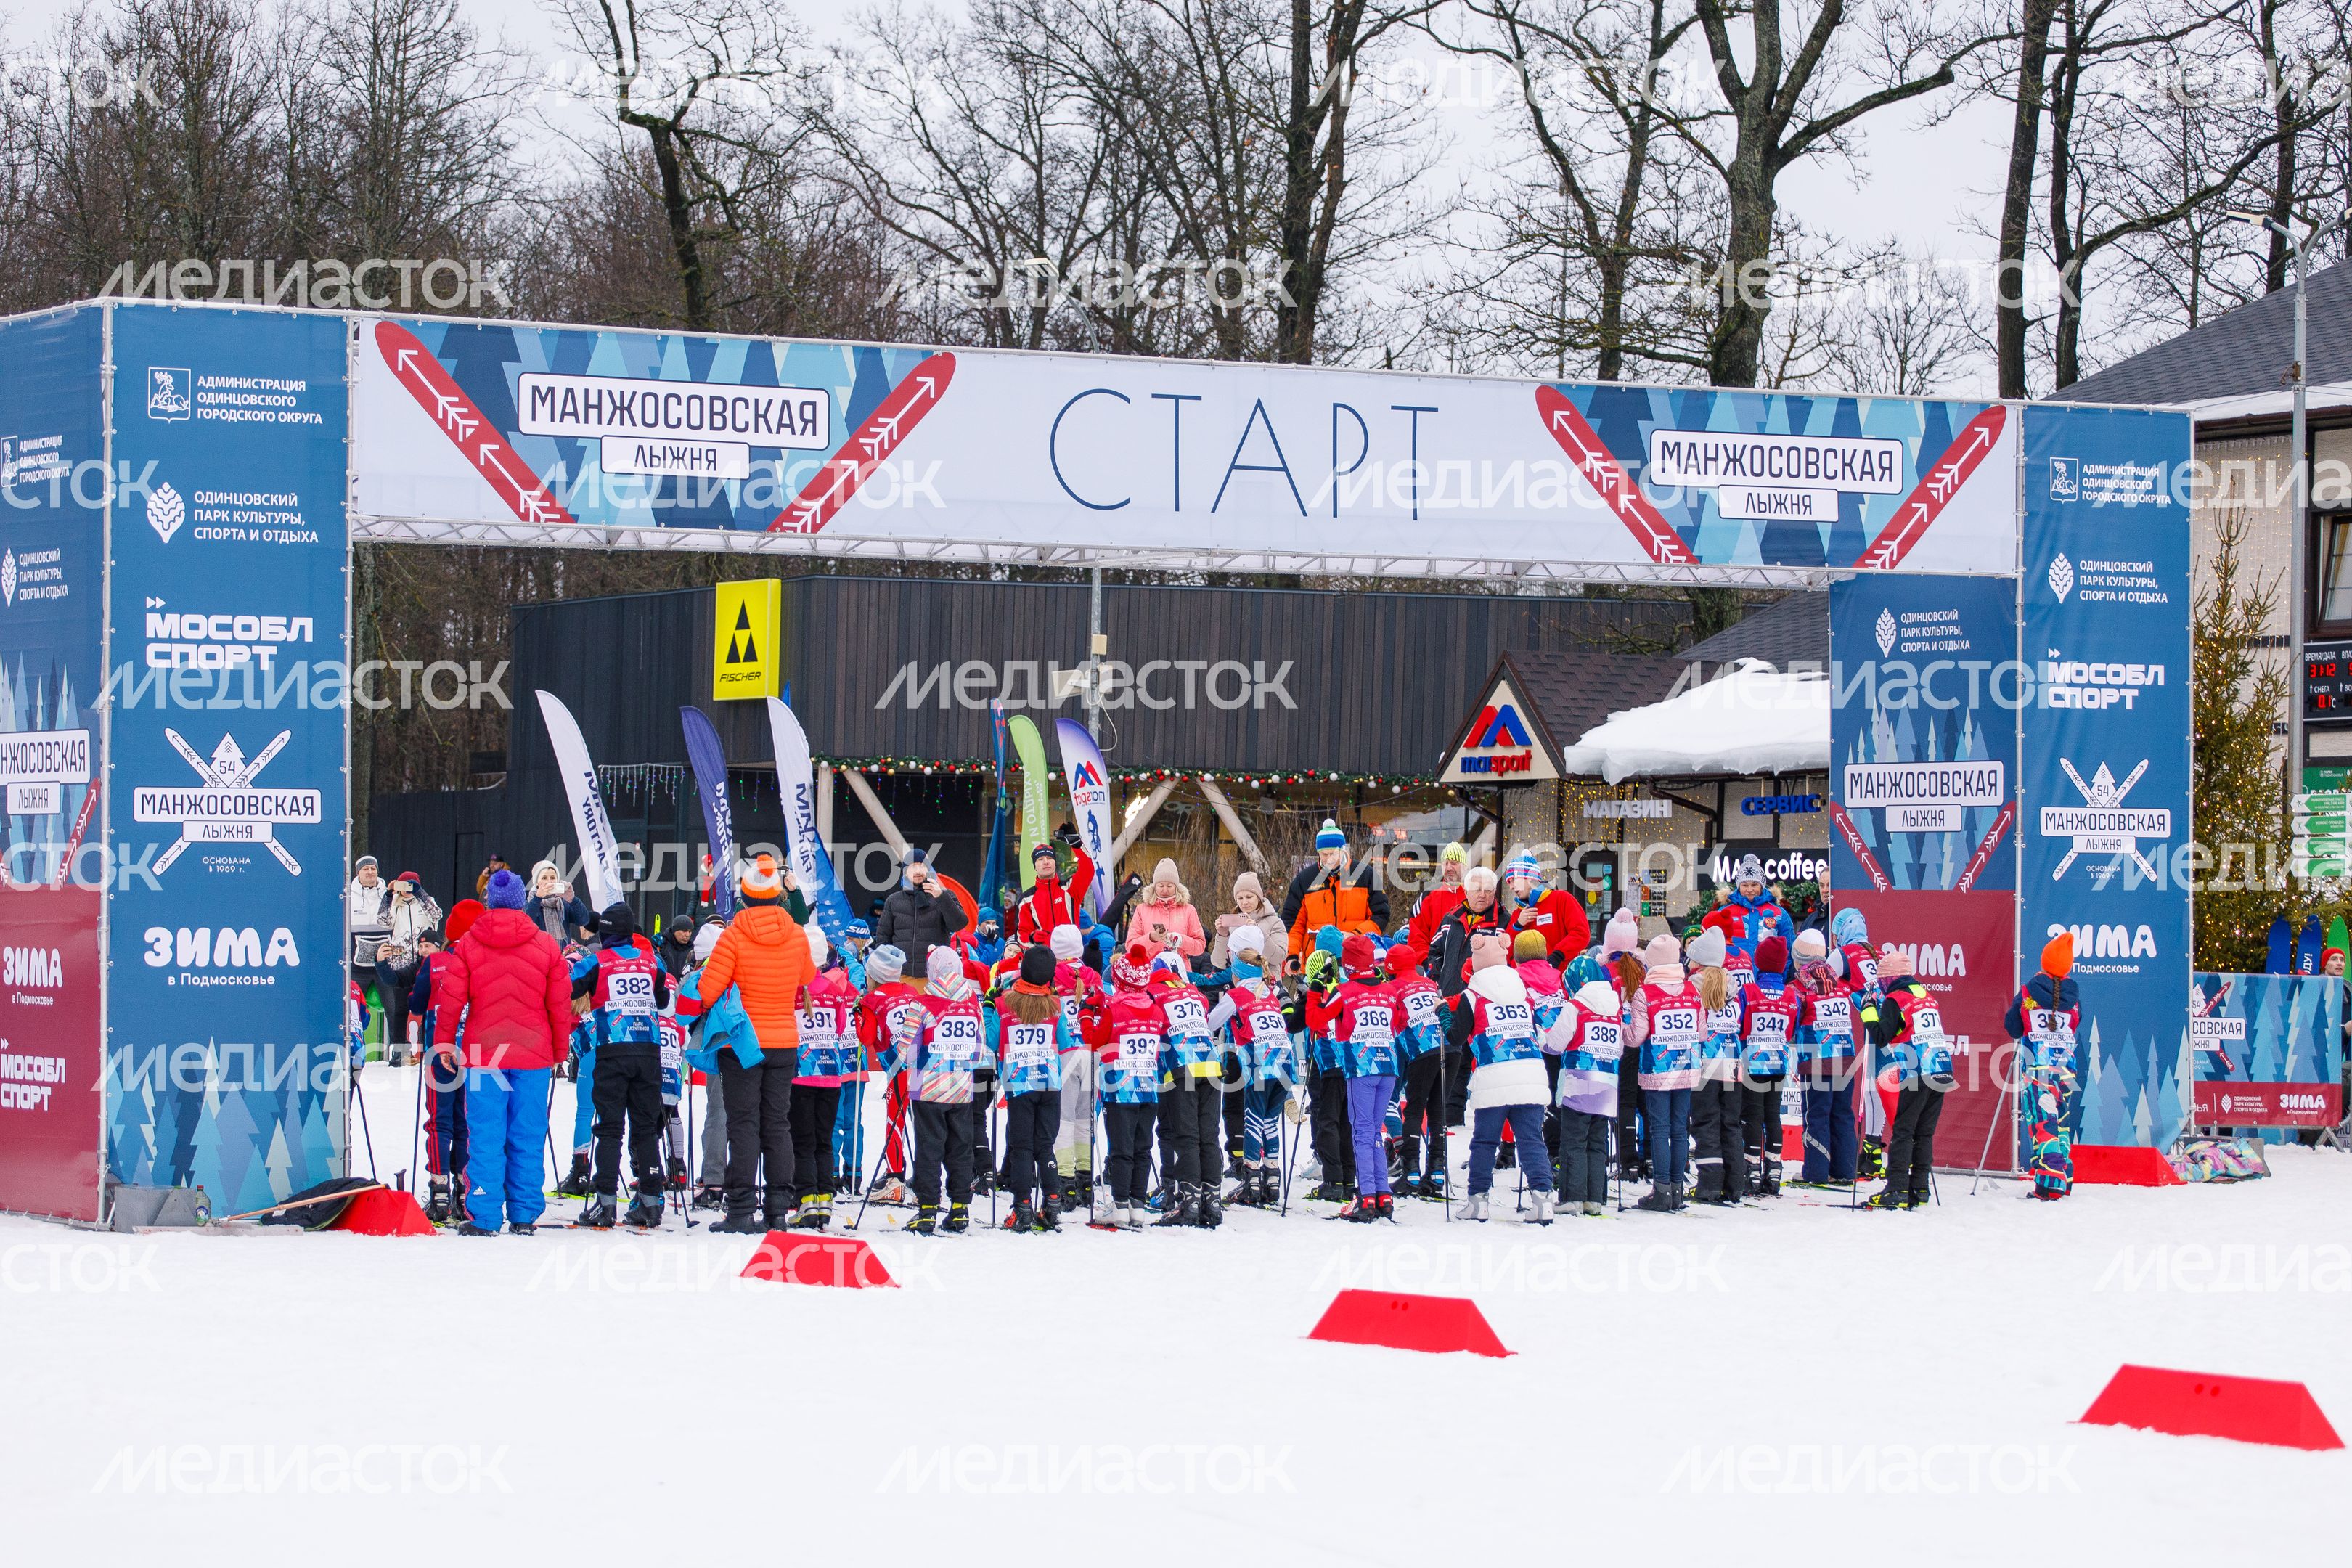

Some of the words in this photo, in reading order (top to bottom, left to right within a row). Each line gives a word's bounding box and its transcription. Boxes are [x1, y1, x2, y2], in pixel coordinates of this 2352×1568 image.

[197, 376, 306, 392] АДМИНИСТРАЦИЯ
[197, 392, 296, 407] ОДИНЦОВСКОГО
[197, 408, 276, 422] ГОРОДСКОГО
[278, 411, 323, 425] ОКРУГА
[531, 385, 818, 436] МАНЖОСОВСКАЯ
[20, 436, 63, 452] АДМИНИСТРАЦИЯ
[20, 452, 59, 468] ОДИНЦОВСКОГО
[634, 444, 717, 472] ЛЫЖНЯ
[1050, 388, 1439, 521] СТАРТ
[1661, 441, 1893, 483] МАНЖОСОВСКАЯ
[20, 468, 51, 483] ГОРОДСКОГО
[51, 467, 70, 479] ОКРУГА
[2083, 465, 2160, 478] АДМИНИСТРАЦИЯ
[2083, 478, 2152, 491] ОДИНЦОВСКОГО
[195, 491, 298, 507] ОДИНЦОВСКИЙ
[1744, 492, 1813, 515] ЛЫЖНЯ
[2082, 491, 2137, 503] ГОРОДСКОГО
[2139, 493, 2171, 505] ОКРУГА
[195, 510, 230, 523] ПАРК
[232, 510, 306, 526] КУЛЬТУРЫ,
[194, 527, 247, 541] СПОРТА
[250, 528, 259, 541] И
[263, 529, 319, 544] ОТДЫХА
[19, 548, 60, 566] ОДИНЦОВСКИЙ
[2080, 560, 2153, 573] ОДИНЦОВСКИЙ
[19, 571, 34, 582] ПАРК
[34, 568, 63, 581] КУЛЬТУРЫ,
[2080, 575, 2104, 587] ПАРК
[2107, 576, 2158, 589] КУЛЬТУРЫ,
[19, 588, 41, 601] СПОРТА
[46, 584, 68, 598] ОТДЫХА
[2080, 590, 2116, 602] СПОРТА
[2118, 591, 2126, 602] И
[2127, 592, 2168, 604] ОТДЫХА
[1900, 609, 1959, 624] ОДИНЦОВСКИЙ
[146, 613, 313, 642] МОСОБЛ
[1900, 626, 1921, 637] ПАРК
[1922, 625, 1963, 638] КУЛЬТУРЫ,
[1900, 641, 1930, 653] СПОРТА
[1932, 641, 1937, 651] И
[1938, 639, 1970, 652] ОТДЫХА
[146, 642, 277, 670] СПОРТ
[2305, 651, 2336, 661] ВРЕМЯ/ДАТА
[719, 671, 761, 683] FISCHER
[2048, 662, 2165, 686] МОСОБЛ
[2048, 687, 2139, 710] СПОРТ
[219, 761, 236, 775] 54
[1461, 749, 1532, 777] marsport
[1850, 769, 1998, 799] МАНЖОСОВСКАЯ
[2097, 785, 2109, 796] 54
[18, 788, 49, 809] ЛЫЖНЯ
[141, 793, 314, 817] МАНЖОСОВСКАЯ
[1742, 793, 1821, 816] СЕРВИС
[1583, 799, 1672, 819] МАГАЗИН
[1902, 809, 1945, 828] ЛЫЖНЯ
[2045, 812, 2165, 832] МАНЖОСОВСКАЯ
[202, 824, 253, 839] ЛЫЖНЯ
[2086, 838, 2122, 851] ЛЫЖНЯ
[1765, 852, 1828, 880] coffee
[144, 927, 301, 967] ЗИМА
[3, 947, 63, 988] ЗИМА
[2073, 963, 2139, 974] Подмосковье
[168, 975, 175, 985] в
[181, 973, 275, 987] Подмосковье
[616, 977, 650, 995] 382
[1919, 984, 1953, 992] осковье
[12, 995, 16, 1003] в
[17, 992, 54, 1006] Подмосковье
[1410, 995, 1436, 1010] 35
[1493, 1005, 1528, 1021] 363
[1822, 1002, 1848, 1016] 342
[1360, 1010, 1389, 1027] 368
[1662, 1013, 1693, 1030] 352
[942, 1021, 976, 1037] 383
[1591, 1026, 1617, 1043] 388
[2192, 1021, 2242, 1035] СОВСКАЯ
[661, 1032, 677, 1048] 60
[1016, 1028, 1045, 1045] 379
[2193, 1040, 2210, 1049] ЖНЯ
[1127, 1038, 1156, 1055] 393
[1, 1054, 65, 1084] МОСОБЛ
[1, 1084, 52, 1111] СПОРТ
[2279, 1093, 2326, 1108] ЗИМА
